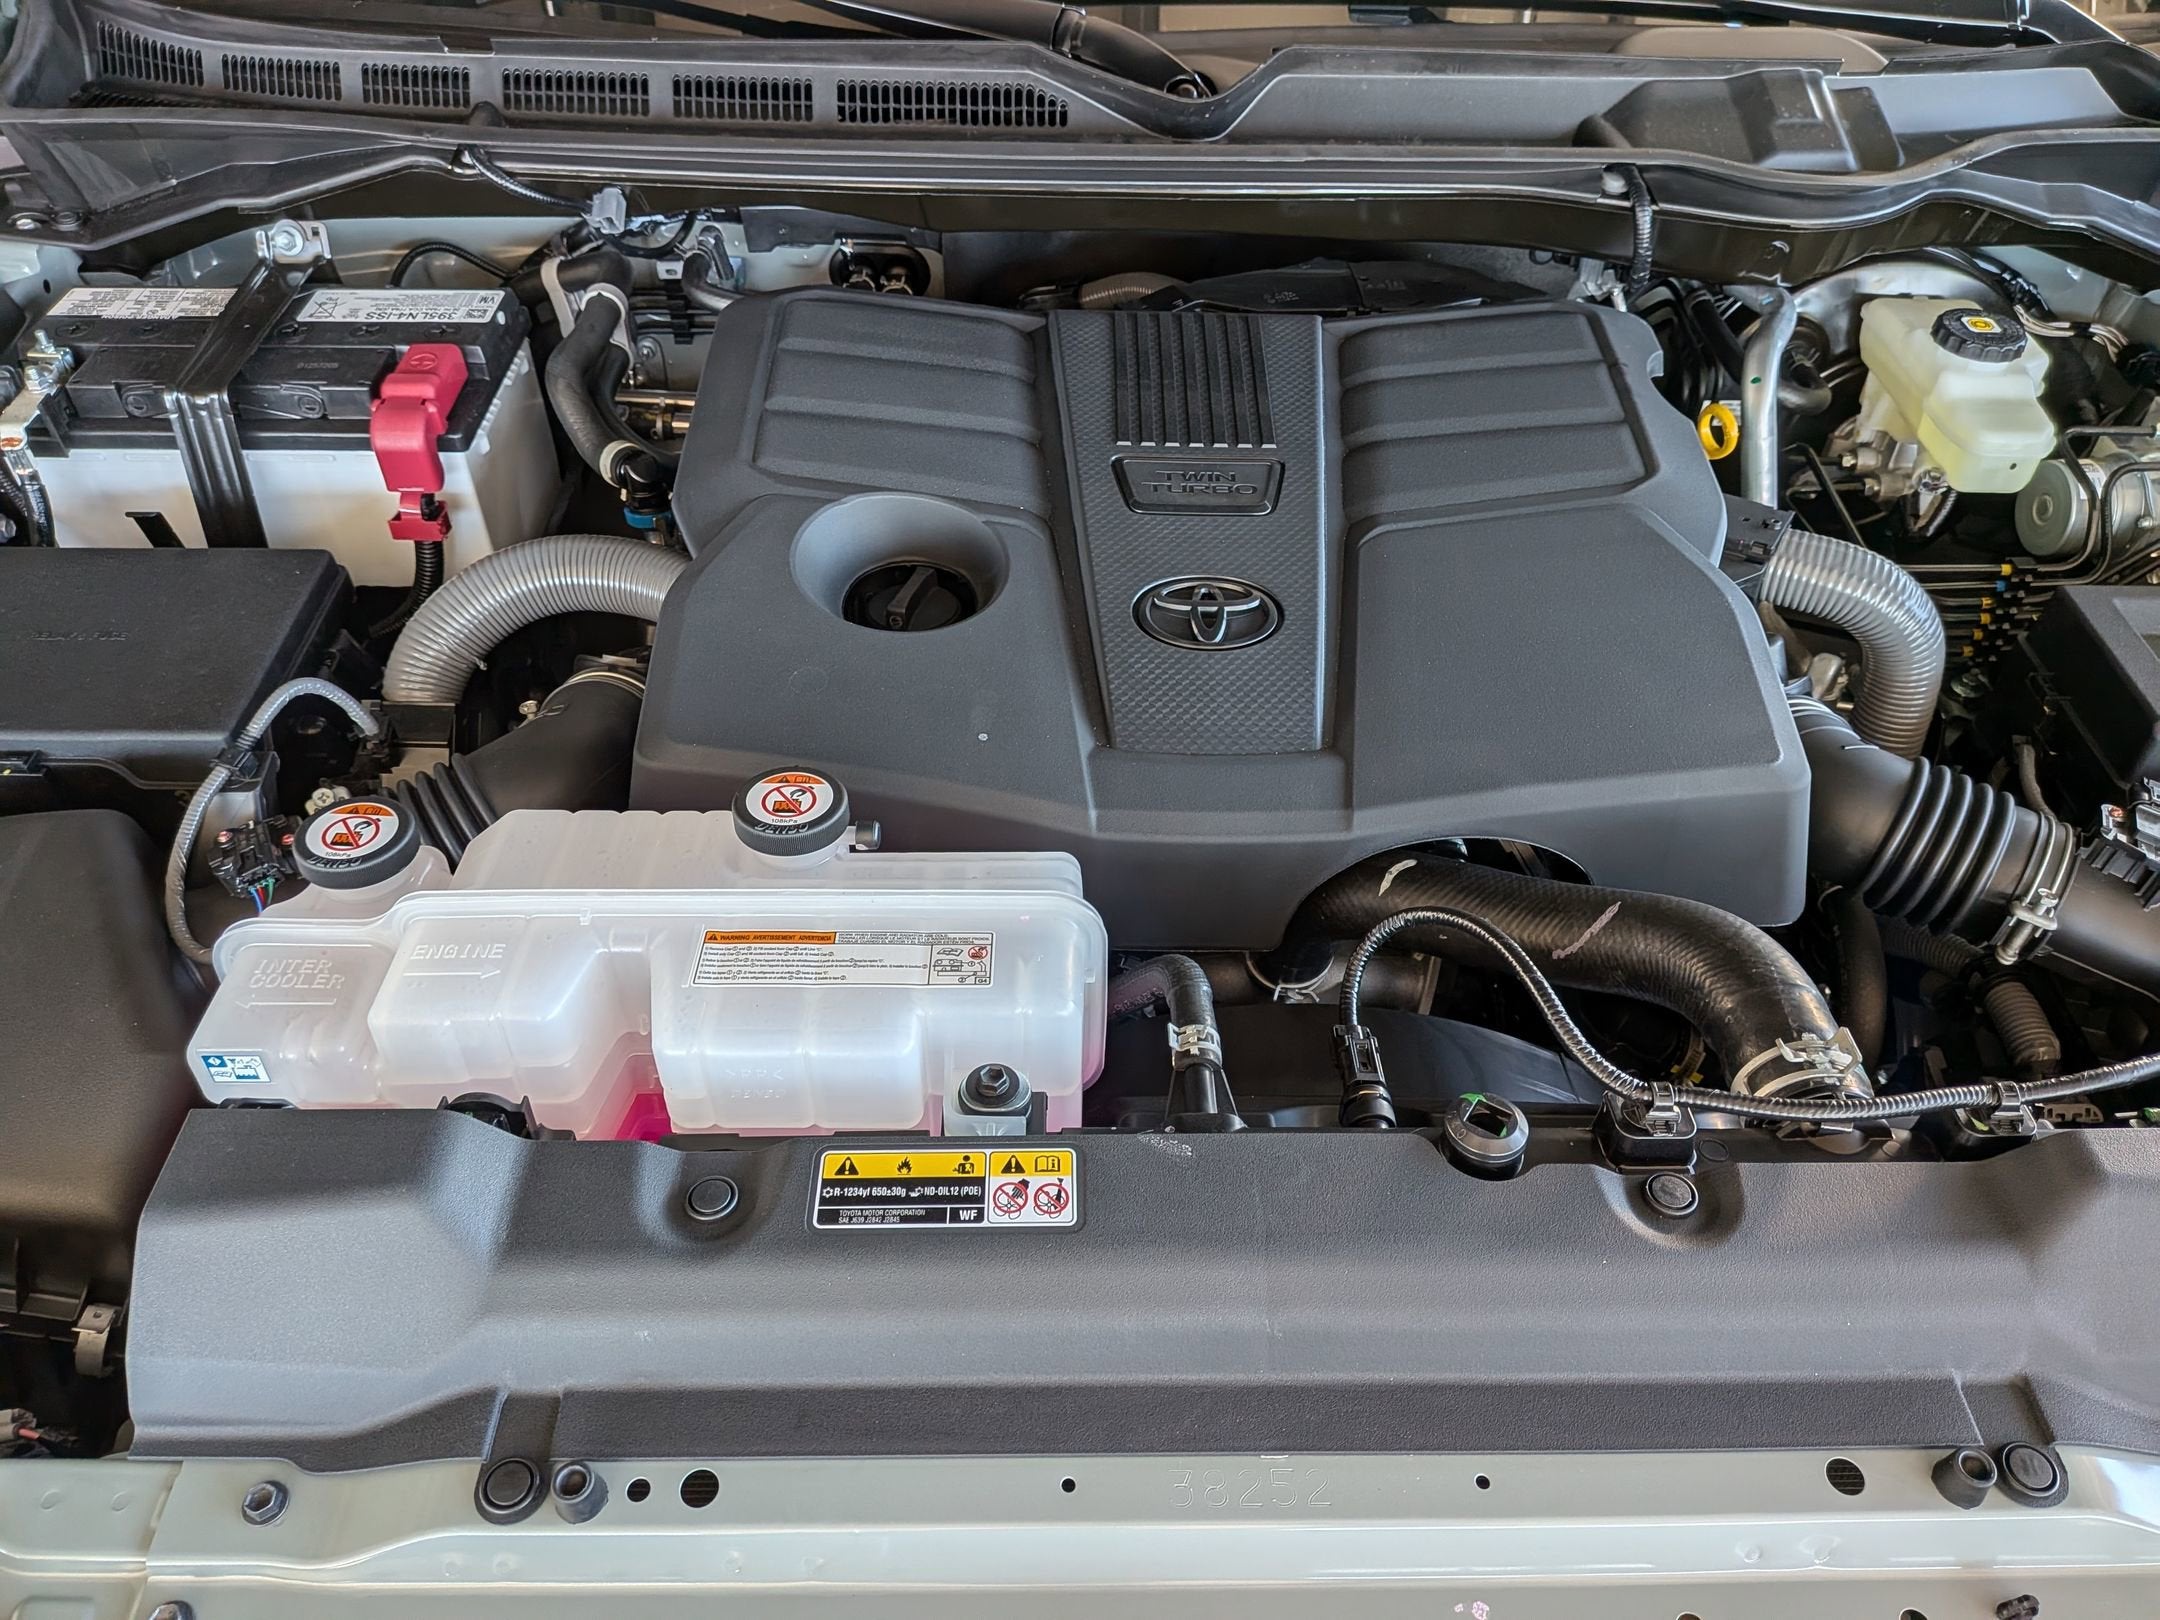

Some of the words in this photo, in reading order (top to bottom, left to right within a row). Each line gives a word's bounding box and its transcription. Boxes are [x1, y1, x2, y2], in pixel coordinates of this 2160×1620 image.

[479, 296, 496, 305] VM
[364, 311, 458, 321] 395LN4-ISS
[1155, 470, 1237, 482] TWIN
[1141, 481, 1258, 495] TURBO
[410, 943, 507, 959] ENGINE
[253, 959, 334, 974] INTER
[248, 973, 346, 989] COOLER
[833, 1186, 870, 1198] R-1234yf
[871, 1186, 907, 1198] 650±30g
[924, 1186, 959, 1196] ND-OIL12
[960, 1186, 982, 1197] (POE)
[839, 1209, 861, 1217] TOYOTA
[862, 1209, 883, 1217] MOTOR
[884, 1209, 926, 1217] CORPORATION
[959, 1209, 978, 1221] WF
[838, 1216, 849, 1224] SAE
[850, 1216, 865, 1224] J639
[865, 1216, 882, 1224] J2842
[1167, 1468, 1332, 1508] 38252
